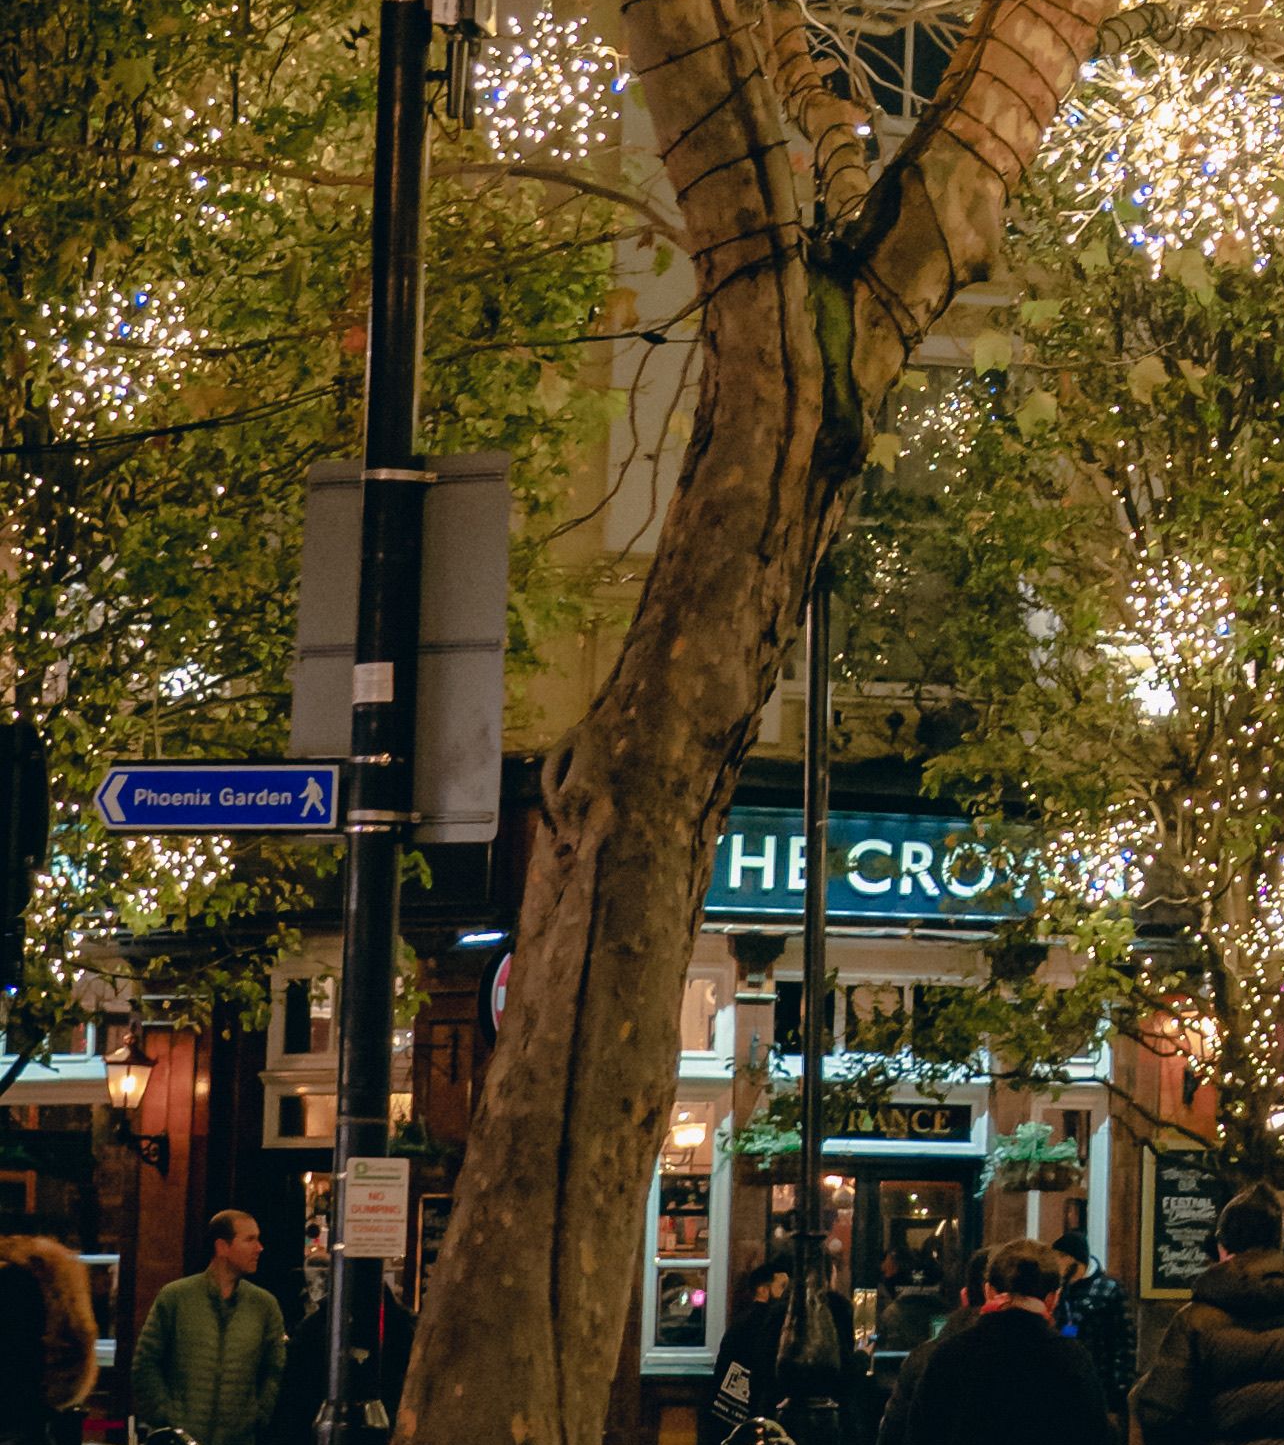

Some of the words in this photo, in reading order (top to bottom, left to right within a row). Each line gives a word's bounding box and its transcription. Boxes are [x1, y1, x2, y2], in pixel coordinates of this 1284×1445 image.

[133, 788, 212, 807] Phoenix
[218, 787, 293, 807] Garden
[716, 834, 808, 890] HE
[368, 1192, 385, 1201] NO
